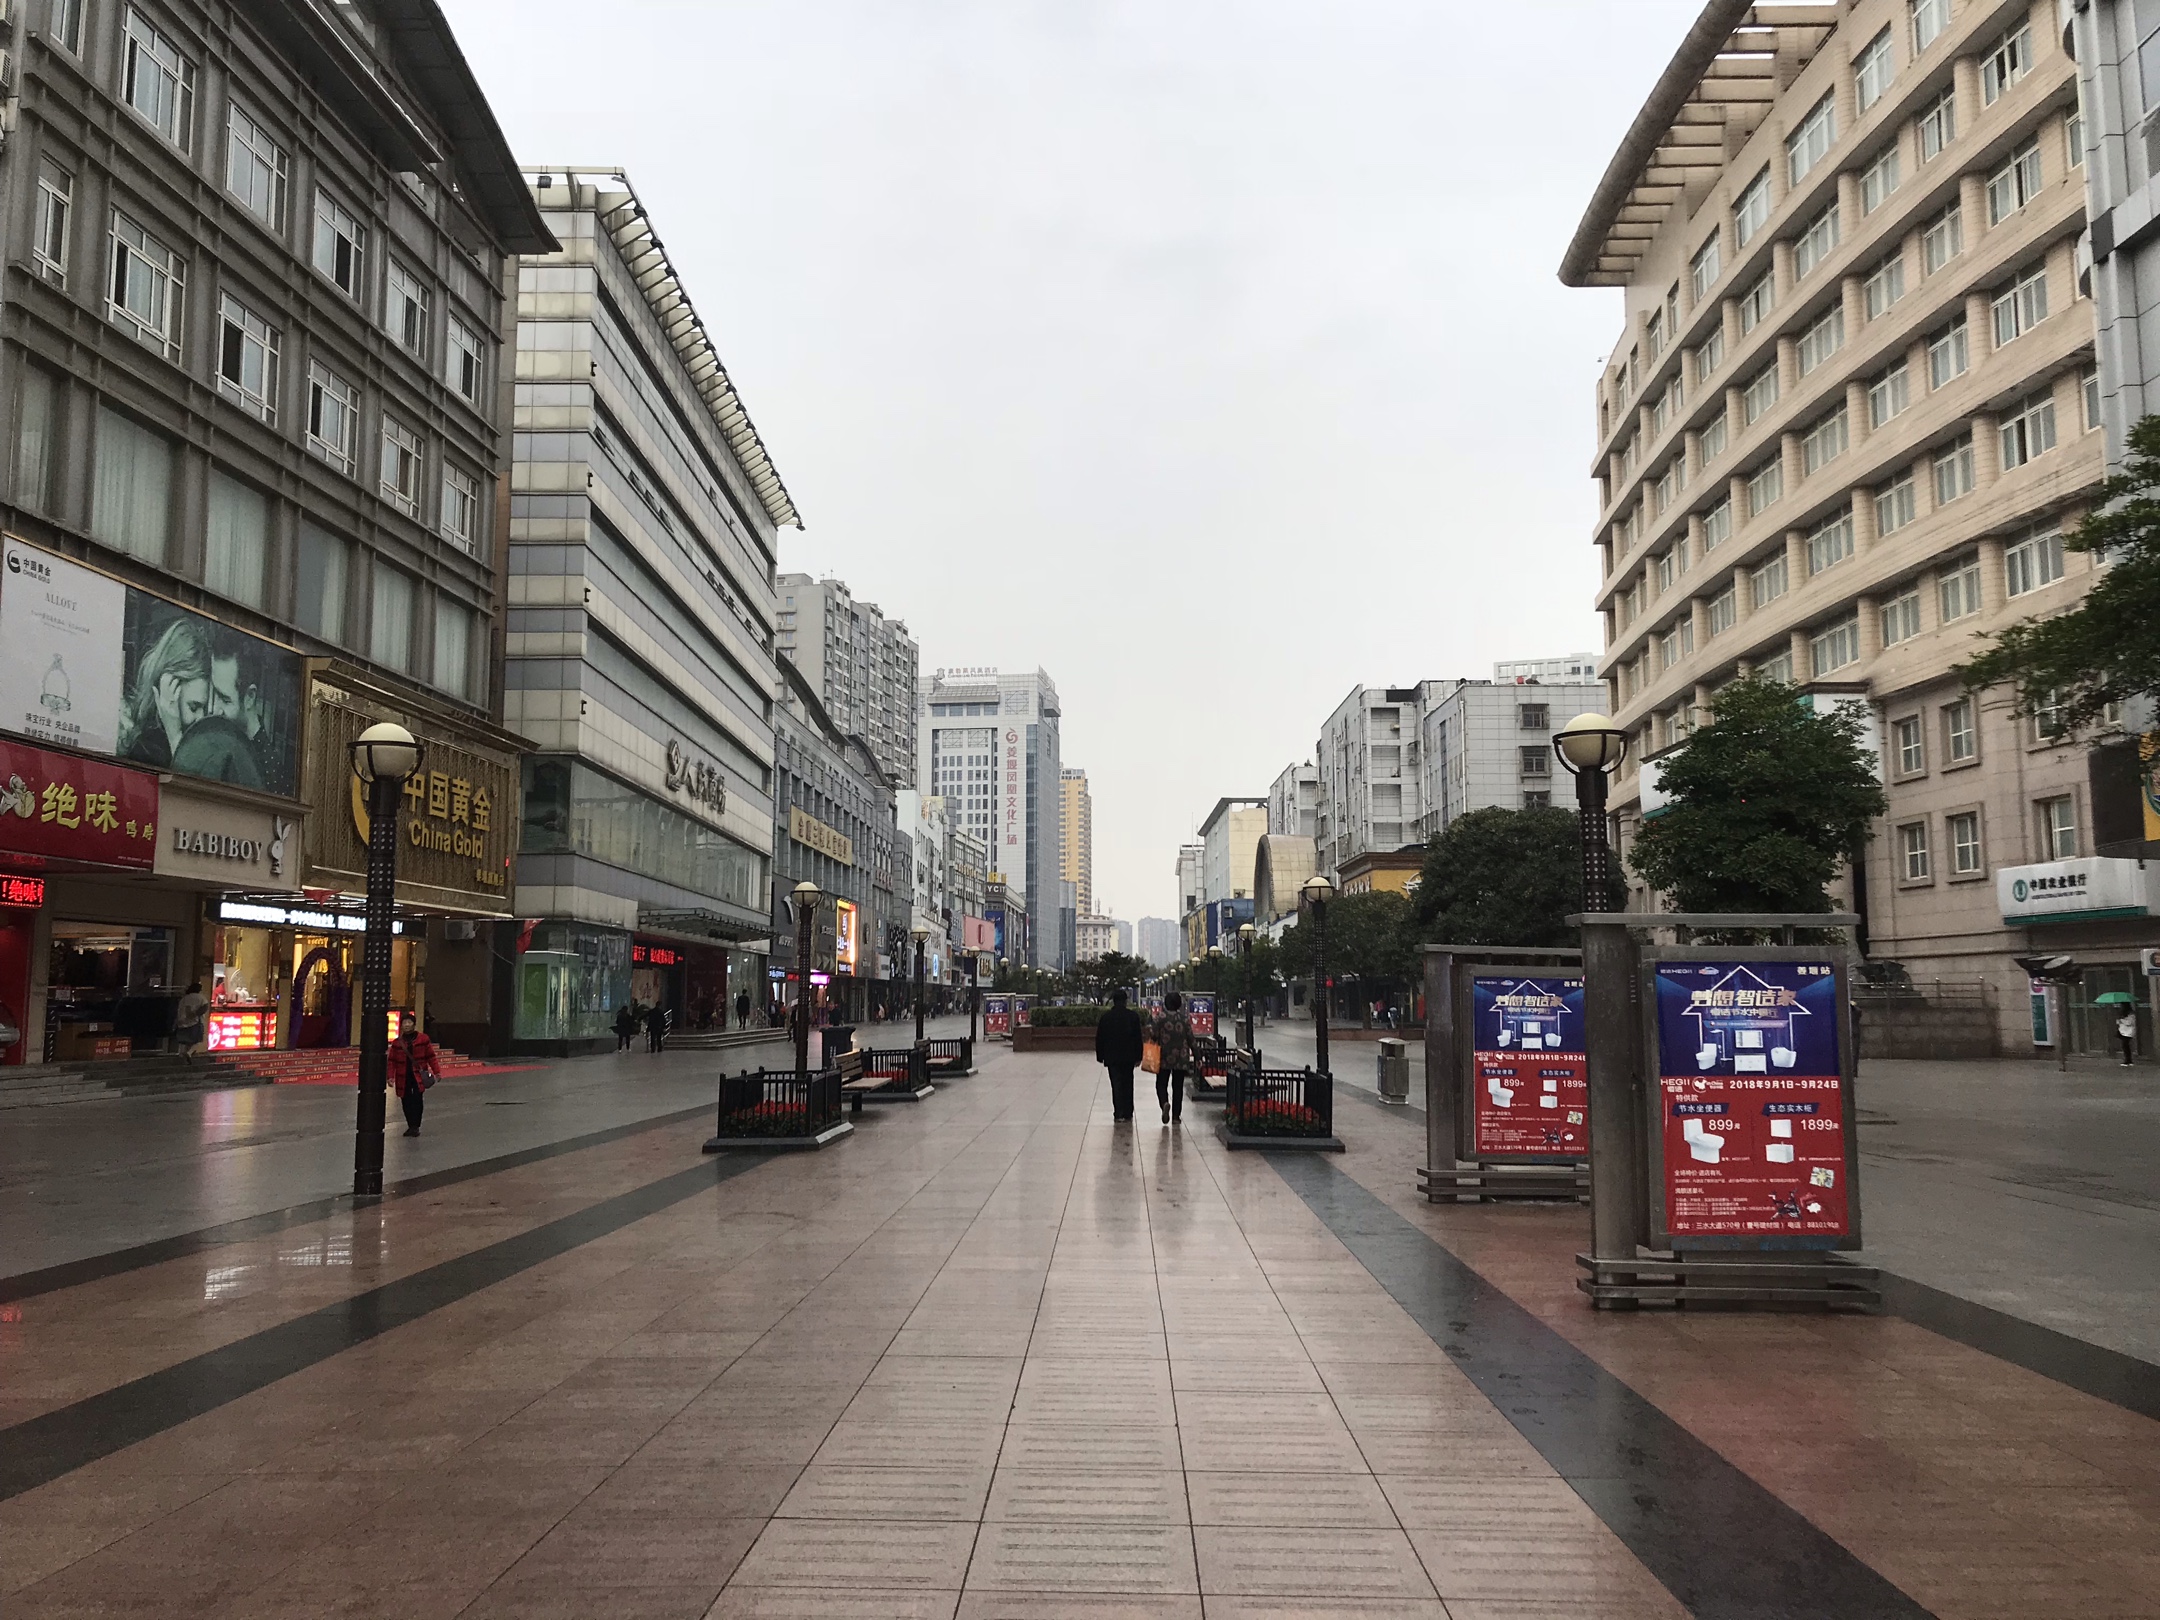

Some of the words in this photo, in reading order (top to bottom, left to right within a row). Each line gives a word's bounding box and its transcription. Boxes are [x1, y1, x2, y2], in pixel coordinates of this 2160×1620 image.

[23, 558, 51, 577] 中国黄金
[25, 712, 51, 727] 珠宝行业
[402, 770, 492, 832] 中国黄金
[1006, 746, 1018, 846] 姜堰凤凰文化广场
[41, 781, 119, 834] 绝味
[177, 828, 263, 862] BABIBOY
[2029, 873, 2087, 891] 中国农业银行
[1660, 1078, 1691, 1086] HEGII
[1679, 1104, 1723, 1114] 节水坐便器
[1768, 1104, 1813, 1114] 生态实木柜
